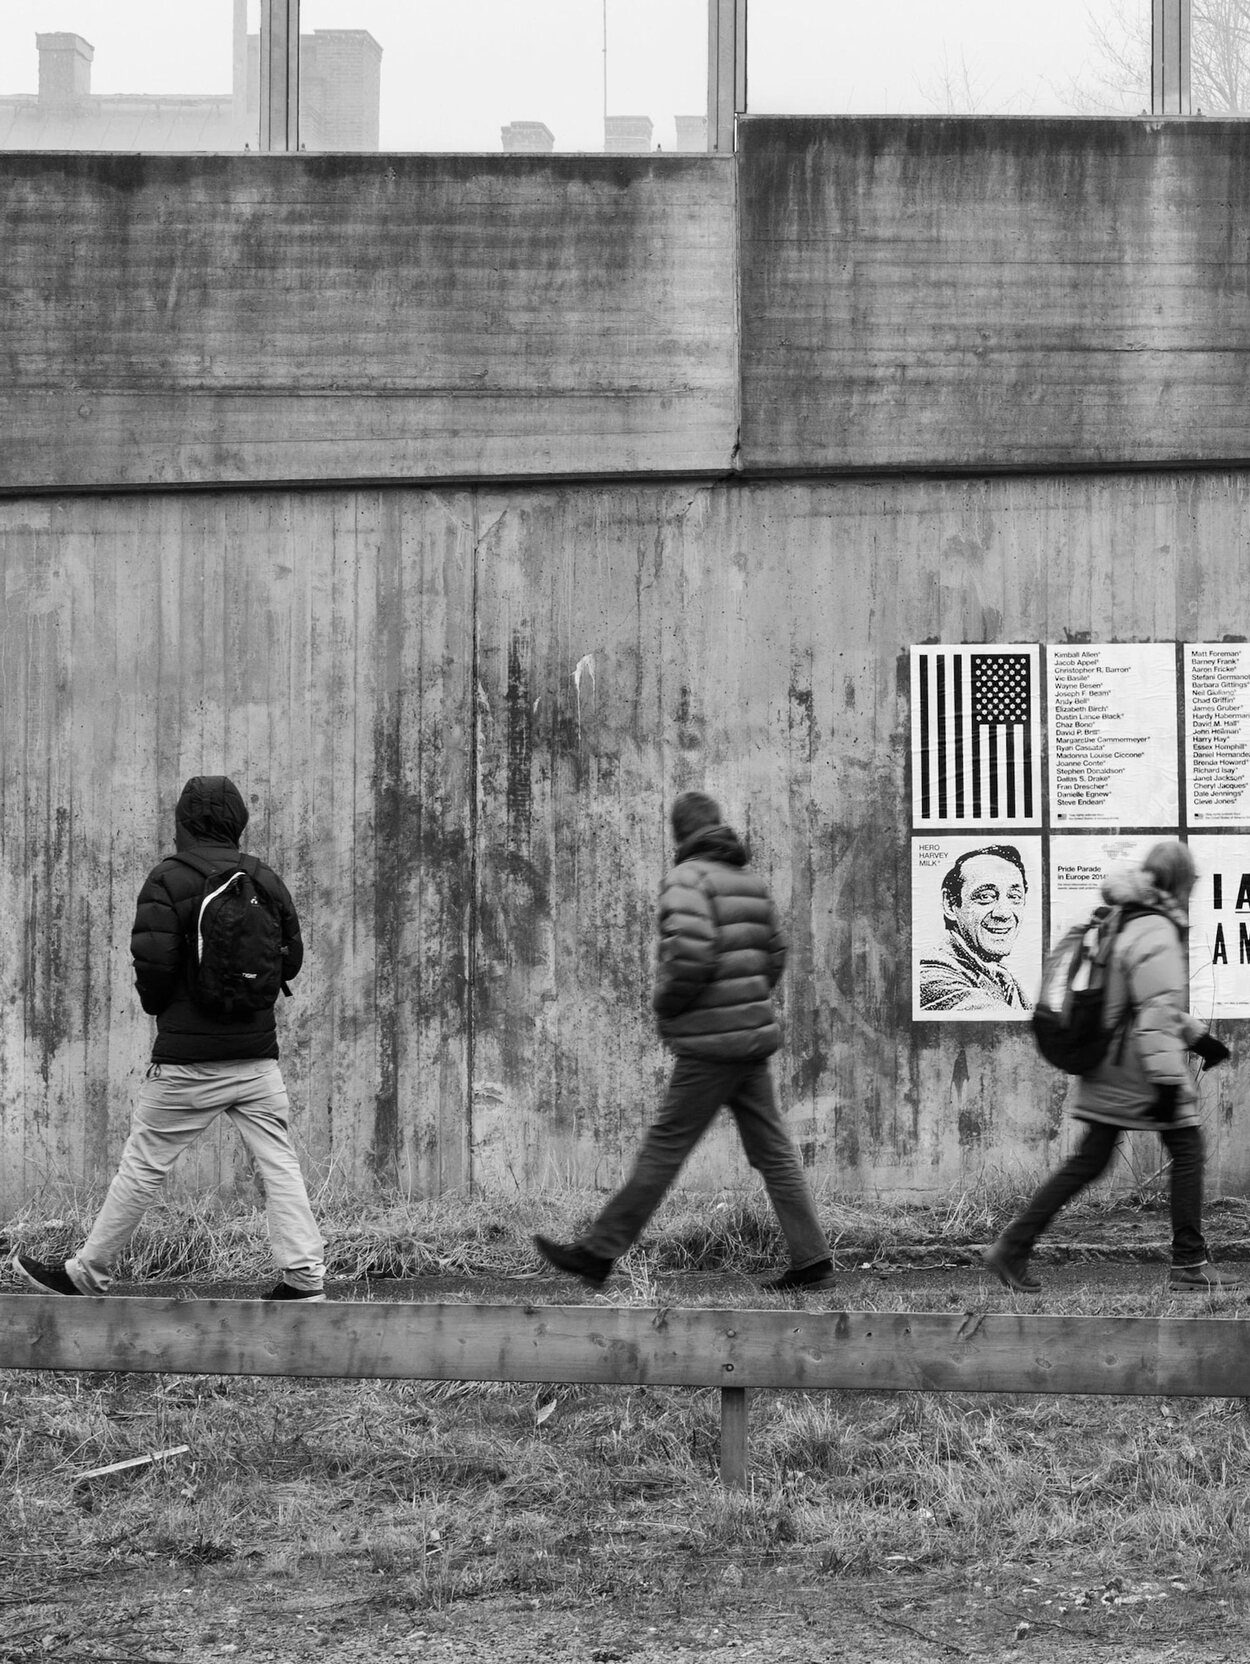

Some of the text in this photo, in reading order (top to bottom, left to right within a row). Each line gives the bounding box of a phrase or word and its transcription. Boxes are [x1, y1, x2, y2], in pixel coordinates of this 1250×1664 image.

[1191, 658, 1216, 666] Barney
[1054, 667, 1095, 675] Christopher
[1054, 683, 1078, 691] Wayne
[1055, 698, 1073, 706] Andy
[1192, 713, 1213, 721] Hardy
[1192, 736, 1212, 744] Harry
[1056, 768, 1085, 776] Stephen
[1213, 874, 1222, 910] I
[1212, 923, 1228, 964] A
